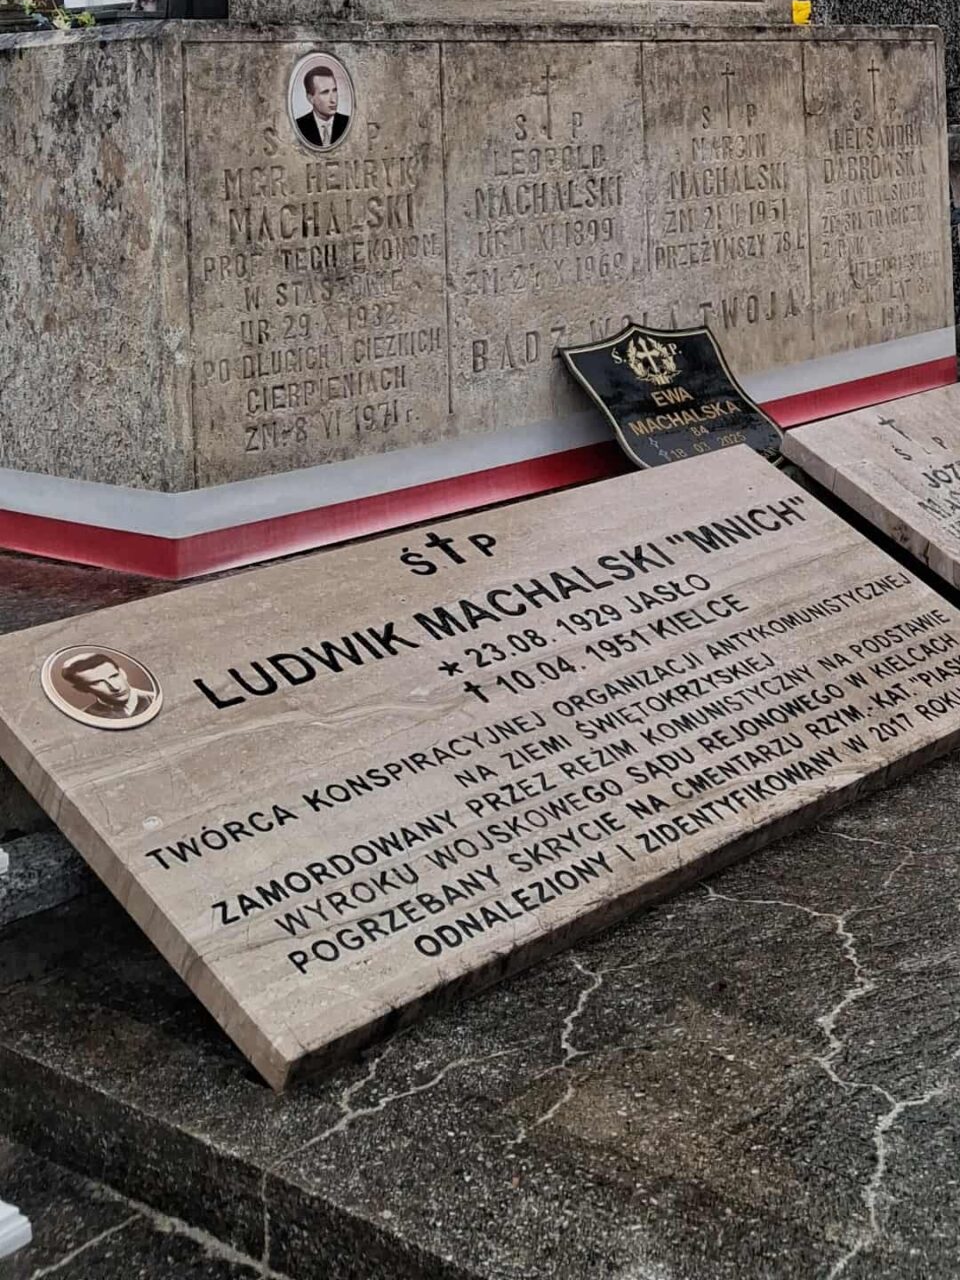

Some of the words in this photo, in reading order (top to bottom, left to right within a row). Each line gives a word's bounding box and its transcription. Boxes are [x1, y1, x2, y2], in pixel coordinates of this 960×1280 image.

[692, 133, 766, 161] MARCIN
[828, 123, 923, 151] ALEKSANDRA
[306, 156, 417, 193] HENRYK
[493, 144, 604, 177] LEOPOLD
[670, 162, 787, 200] MACHALSKI
[228, 193, 415, 244] MACHALSKI
[474, 176, 623, 219] MACHALSKI
[655, 234, 765, 270] PRZEŻYWSZY
[244, 287, 260, 311] W
[699, 288, 799, 330] TWOJA
[202, 359, 231, 387] PO
[247, 365, 406, 414] CIERPIENIACH
[628, 400, 742, 436] MACHALSKA
[651, 386, 694, 407] EWA
[399, 547, 438, 576] Ś
[468, 533, 497, 557] P
[193, 622, 421, 710] LUDWIK
[412, 542, 675, 641] MACHALSKI
[665, 495, 807, 555] "MNICH"
[557, 603, 623, 636] 1929
[629, 573, 711, 614] JASŁO
[585, 628, 651, 663] 1951
[647, 593, 750, 640] KIELCE
[145, 804, 298, 870] TWÓRCA
[302, 710, 547, 812] KONSPIRACYJNEJ
[552, 651, 704, 717] ORGANIZACJI
[706, 571, 912, 660] ANTYKOMUNISTYCZNEJ
[454, 764, 498, 788] NA
[500, 734, 572, 770] ZIEMI
[575, 652, 775, 740] ŚWIĘTOKRZYSKIEJ
[211, 809, 458, 926] ZAMORDOWANY
[465, 772, 557, 818] PRZEZ
[559, 738, 639, 780] REŻIM
[640, 664, 815, 747] KOMUNISTYCZNY
[817, 652, 853, 672] NA
[849, 609, 951, 659] PODSTAWIE
[274, 862, 420, 937] WYROKU
[425, 778, 623, 870] WOJSKOWEGO
[625, 747, 696, 784] SĄDU
[697, 683, 845, 755] REJONOWEGO
[845, 671, 869, 689] W
[868, 632, 960, 680] KIELCACH
[287, 864, 501, 975] POGRZEBANY
[508, 812, 626, 872] SKRYCIE
[625, 793, 670, 821] NA
[671, 733, 804, 800] CMENTARZU
[414, 851, 613, 957] ODNALEZIONY
[616, 844, 636, 862] I
[635, 746, 842, 854] ZIDENTYFIKOWANY
[842, 734, 869, 754] W
[869, 713, 915, 743] 2017
